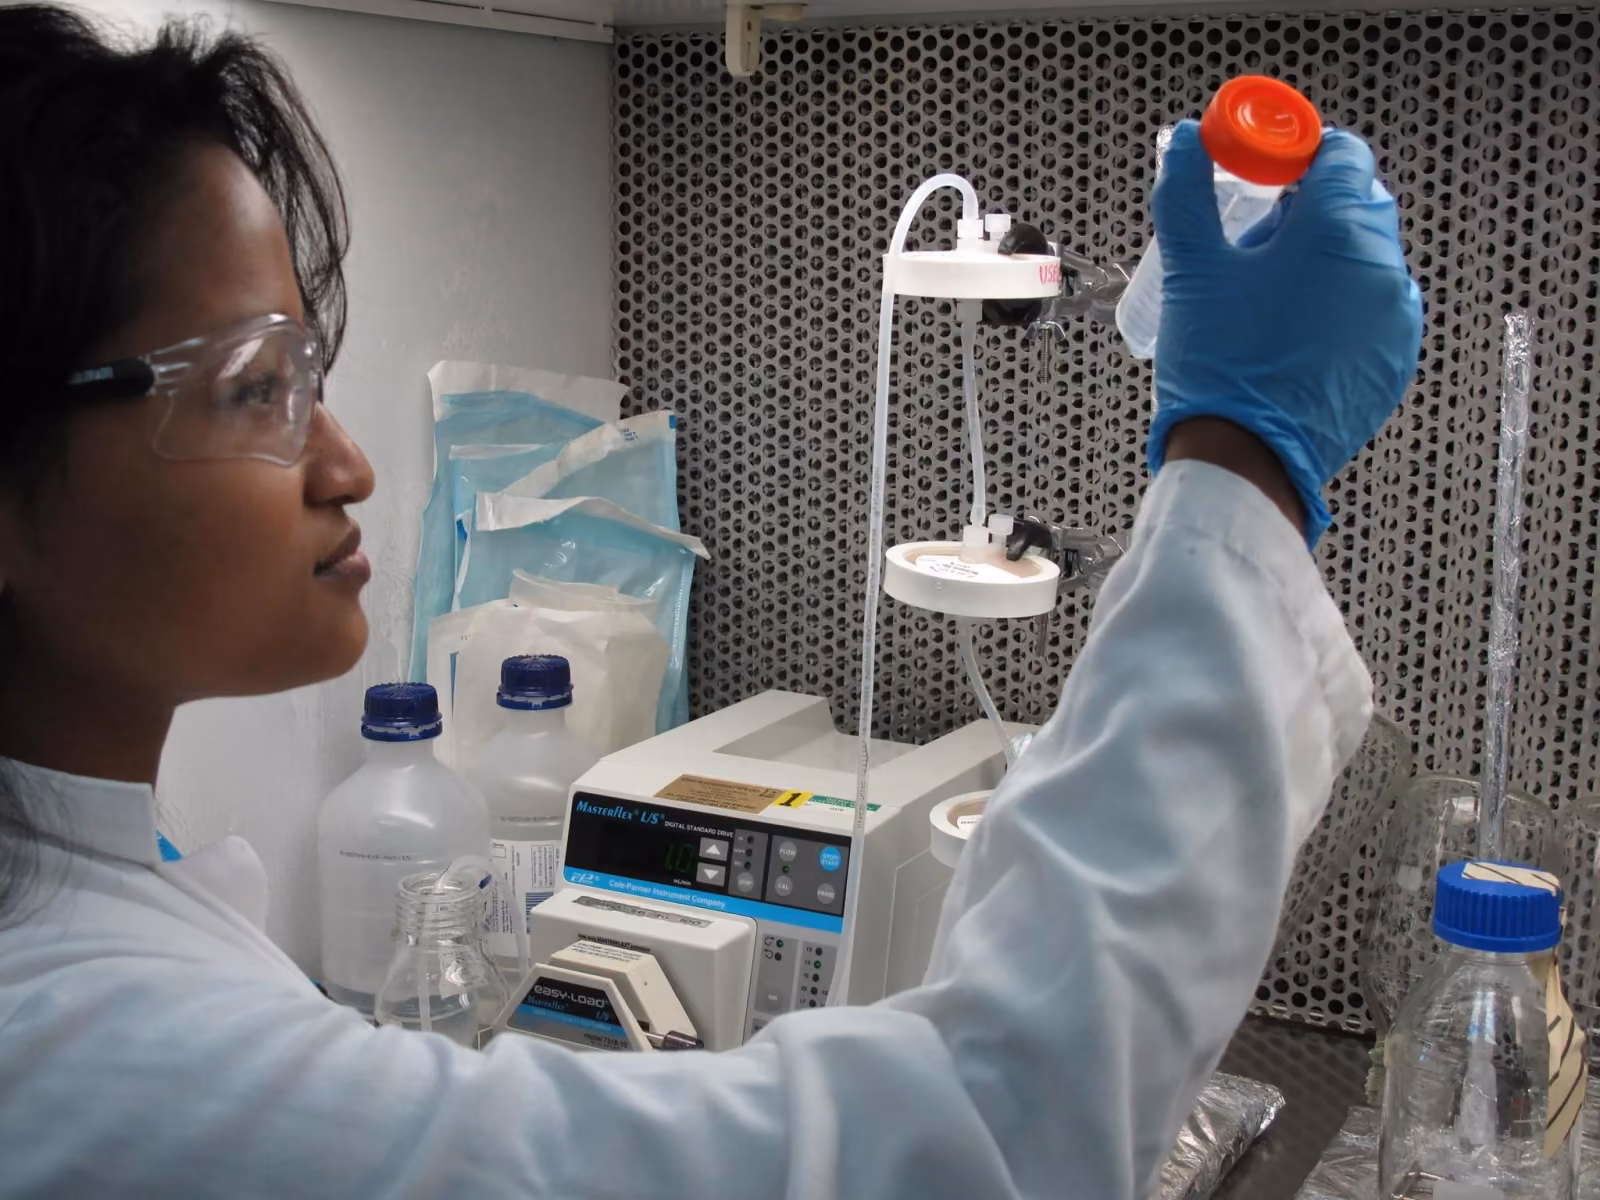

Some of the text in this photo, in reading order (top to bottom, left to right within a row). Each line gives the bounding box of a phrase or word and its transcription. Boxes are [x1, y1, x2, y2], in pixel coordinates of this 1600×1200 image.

[779, 792, 802, 807] 1
[640, 811, 659, 825] L/S
[664, 820, 686, 831] DIGITAL
[687, 824, 717, 836] STANDARD
[717, 828, 734, 838] DRIVE
[779, 848, 797, 857] FLOW
[609, 879, 725, 909] Cole-Parmer Instrument Company
